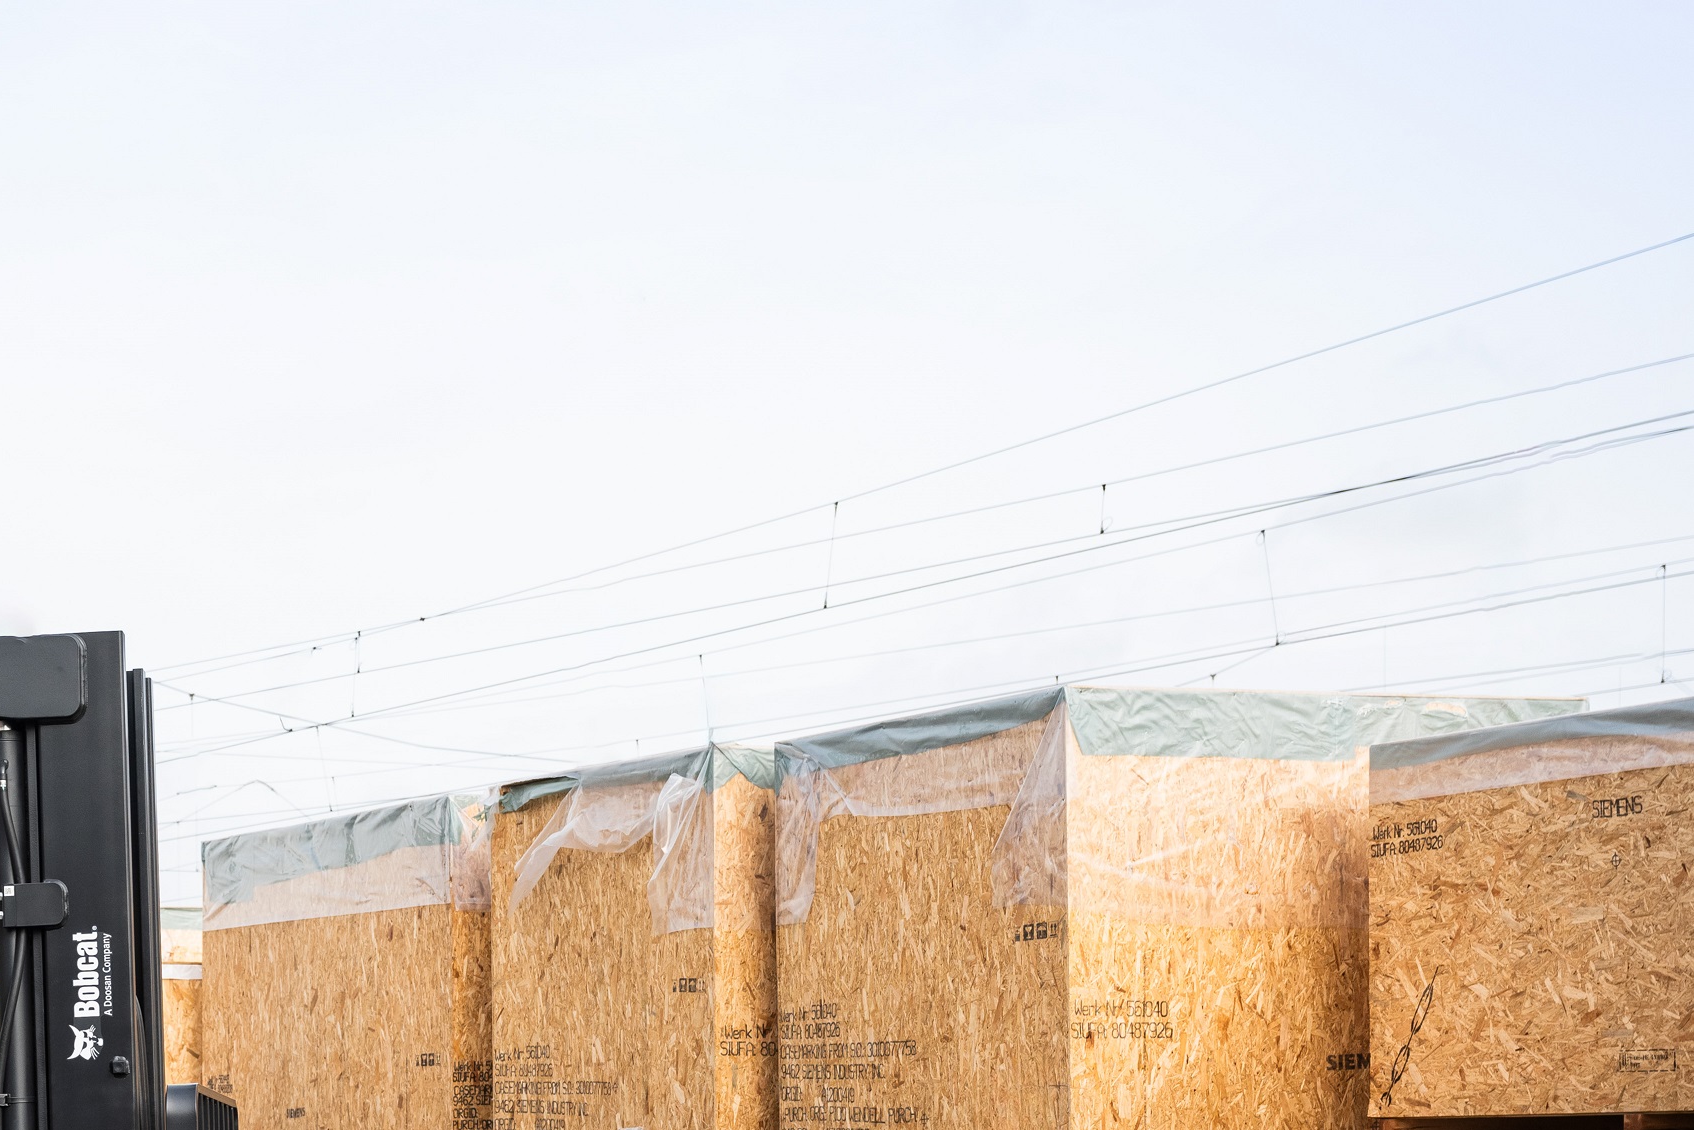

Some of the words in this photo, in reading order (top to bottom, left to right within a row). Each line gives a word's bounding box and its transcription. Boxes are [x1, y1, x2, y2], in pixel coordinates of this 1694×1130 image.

[1592, 795, 1643, 818] SIEMENS
[1372, 825, 1392, 840] Werk
[1398, 835, 1444, 854] 80487926
[102, 933, 113, 974] Company
[72, 931, 101, 1018] Bobcat
[103, 975, 113, 1007] Doosan
[103, 1008, 113, 1017] A
[1074, 999, 1102, 1016] Werk
[1126, 1000, 1169, 1018] 561040
[724, 1025, 752, 1040] Werk
[1112, 1022, 1174, 1039] 80487926
[494, 1049, 512, 1062] Werk
[760, 1041, 778, 1057] 80
[829, 1042, 849, 1059] FROM
[867, 1040, 917, 1057] 3010077758
[781, 1064, 800, 1079] 9462
[803, 1064, 831, 1079] SIEMENS
[833, 1064, 869, 1079] INDUSTRY
[495, 1081, 542, 1095] CASEMARKING
[542, 1081, 561, 1095] FROM
[452, 1095, 474, 1106] 9462
[495, 1100, 514, 1114] 9462
[516, 1100, 545, 1115] SIEMENS
[547, 1101, 576, 1115] INDUSTRY
[286, 1107, 306, 1119] SIEMENS
[849, 1107, 885, 1124] WENDELL
